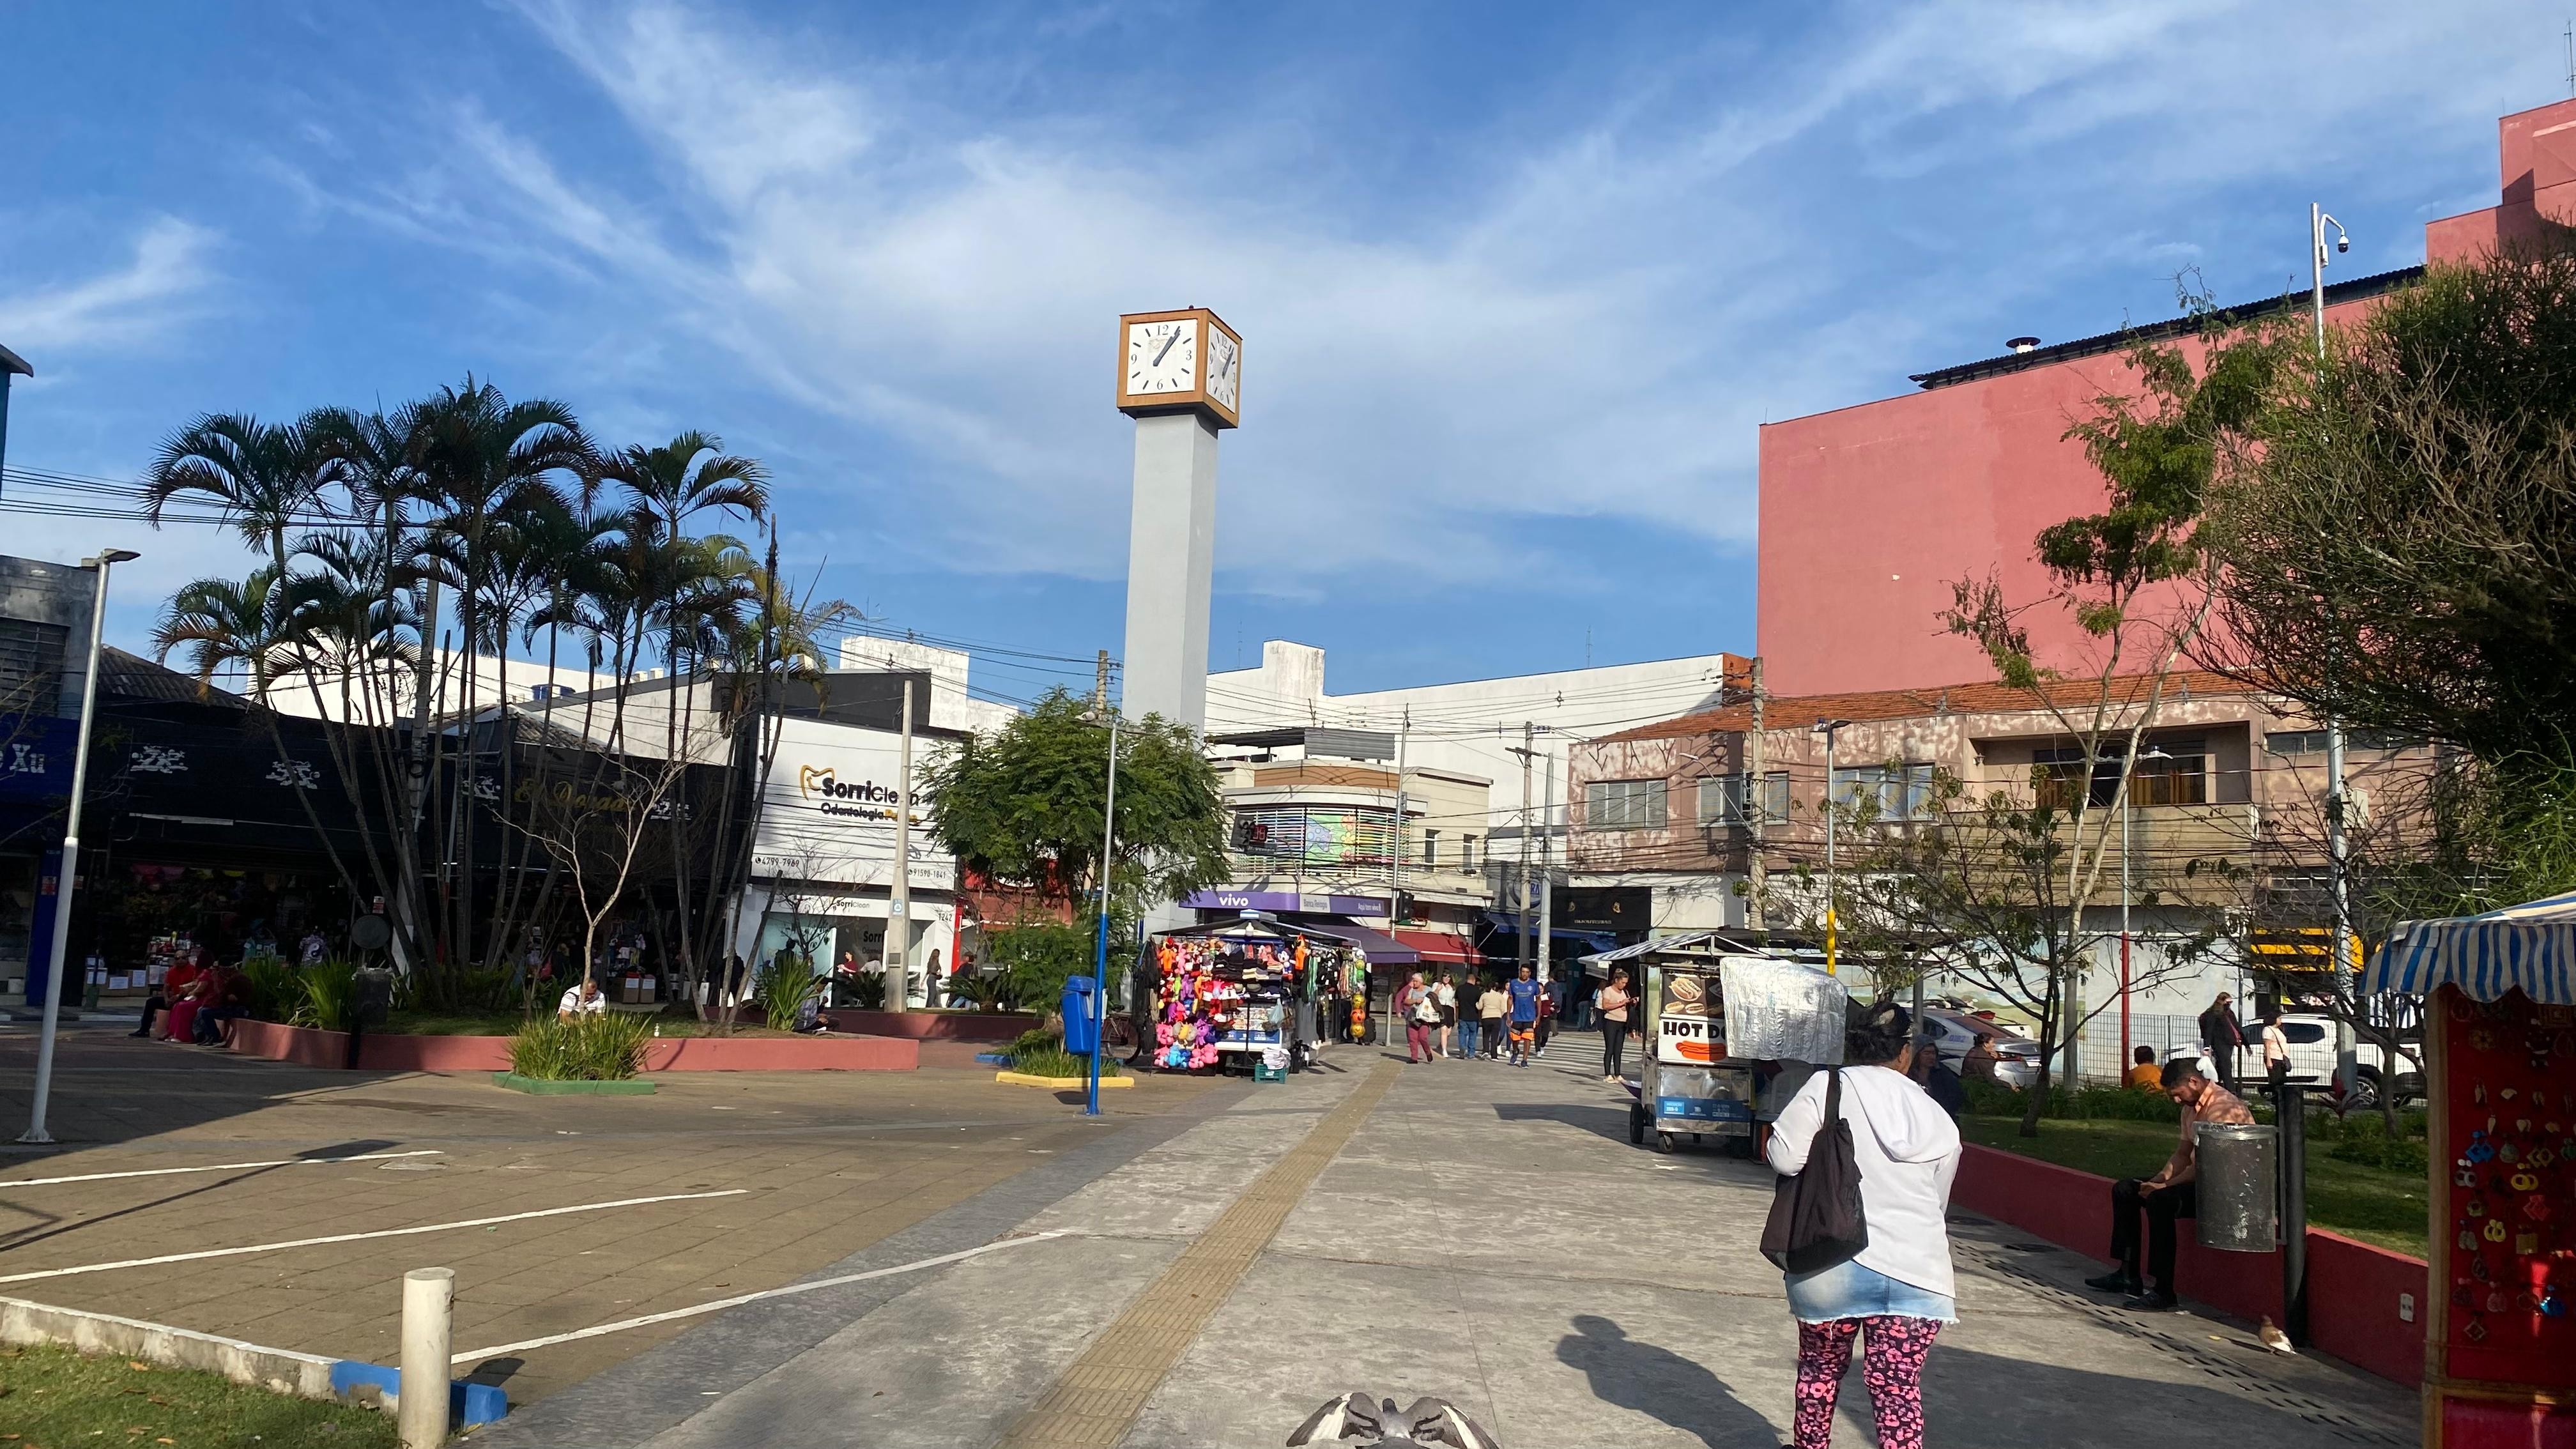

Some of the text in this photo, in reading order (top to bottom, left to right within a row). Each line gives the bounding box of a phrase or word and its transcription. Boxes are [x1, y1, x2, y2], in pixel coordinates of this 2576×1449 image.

[1157, 324, 1169, 336] 12
[1131, 354, 1137, 365] 9
[1185, 349, 1192, 361] 3
[1156, 378, 1163, 390] 6
[1220, 390, 1224, 401] 6
[822, 777, 919, 807] SorriClen
[836, 900, 870, 909] SorriClean
[1219, 894, 1249, 907] vivo
[938, 912, 953, 922] 1242
[1663, 1021, 1703, 1038] HOT
